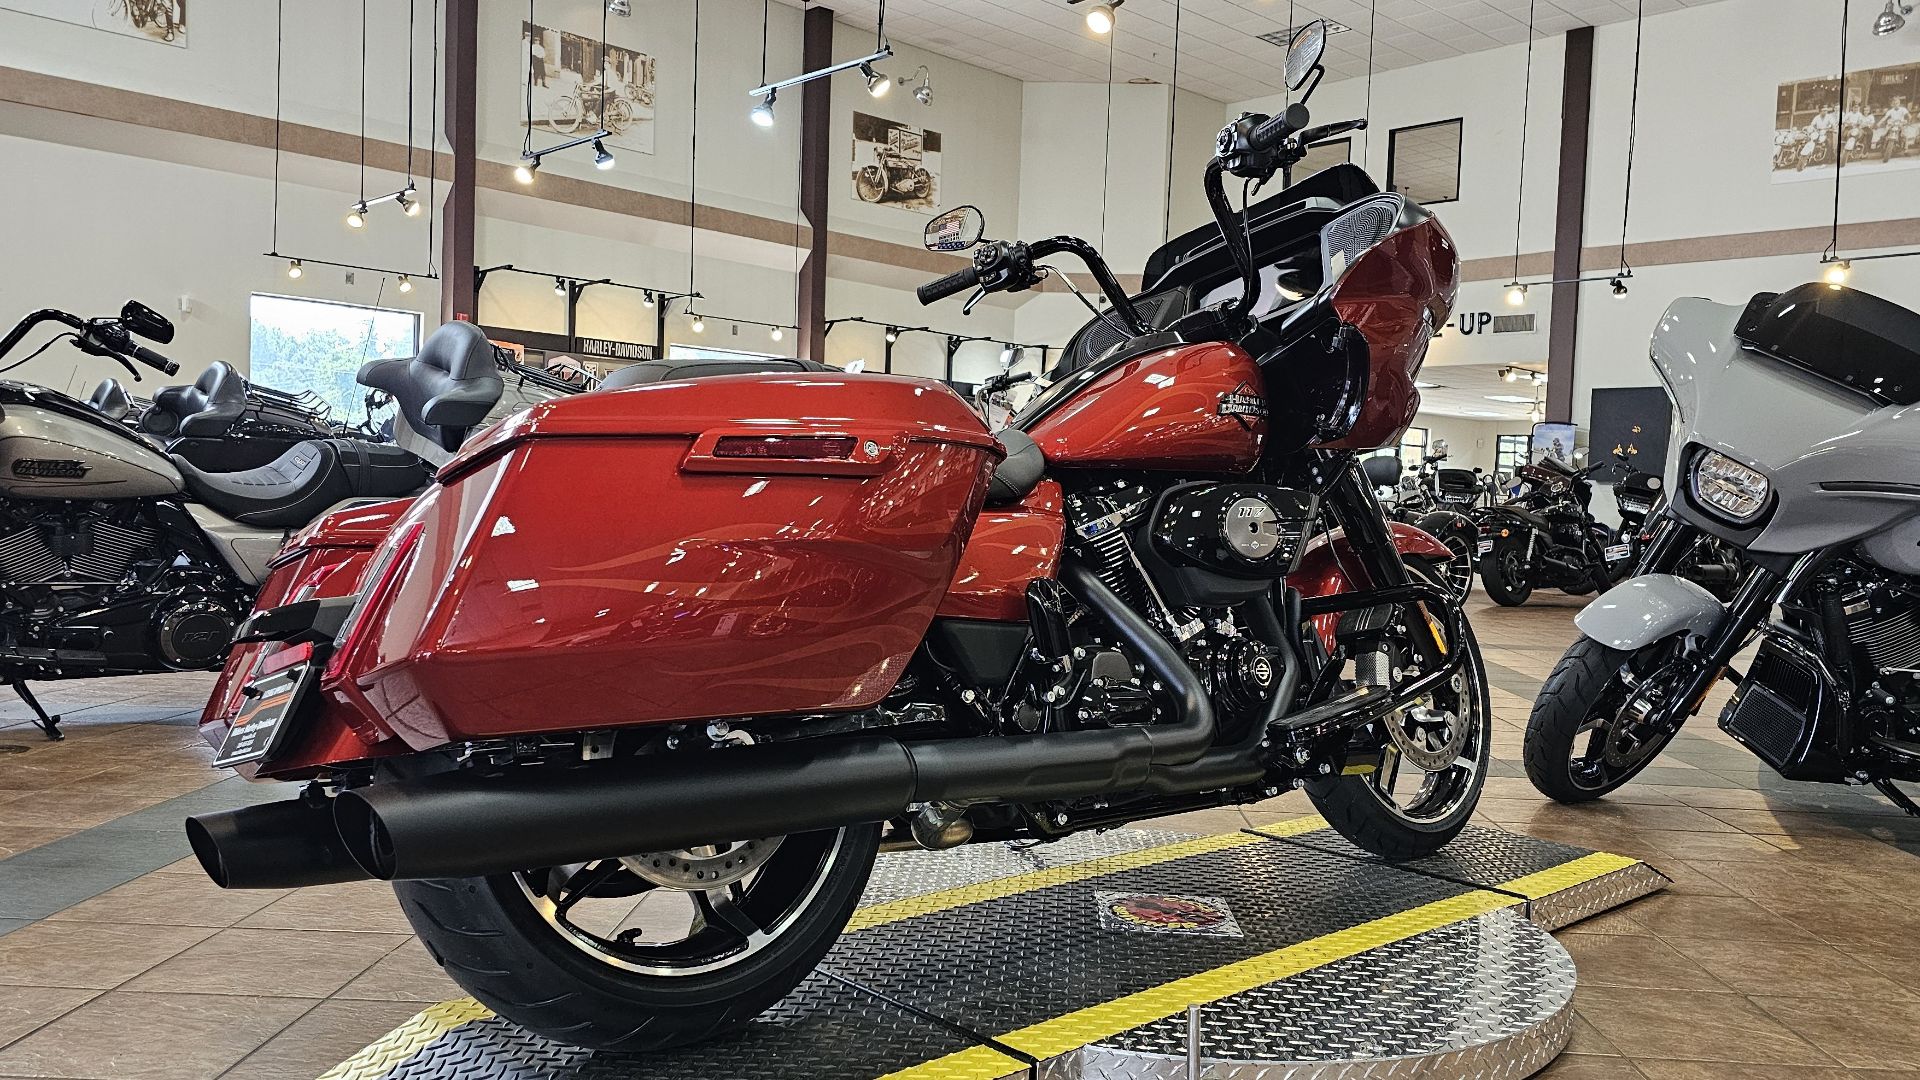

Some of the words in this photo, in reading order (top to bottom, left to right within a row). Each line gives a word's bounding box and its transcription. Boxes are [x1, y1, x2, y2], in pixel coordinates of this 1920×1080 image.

[1433, 311, 1492, 338] -UP
[583, 339, 653, 360] HARLEY-DAVIDSON
[16, 468, 83, 476] DAVIDSON
[1237, 506, 1267, 519] 117
